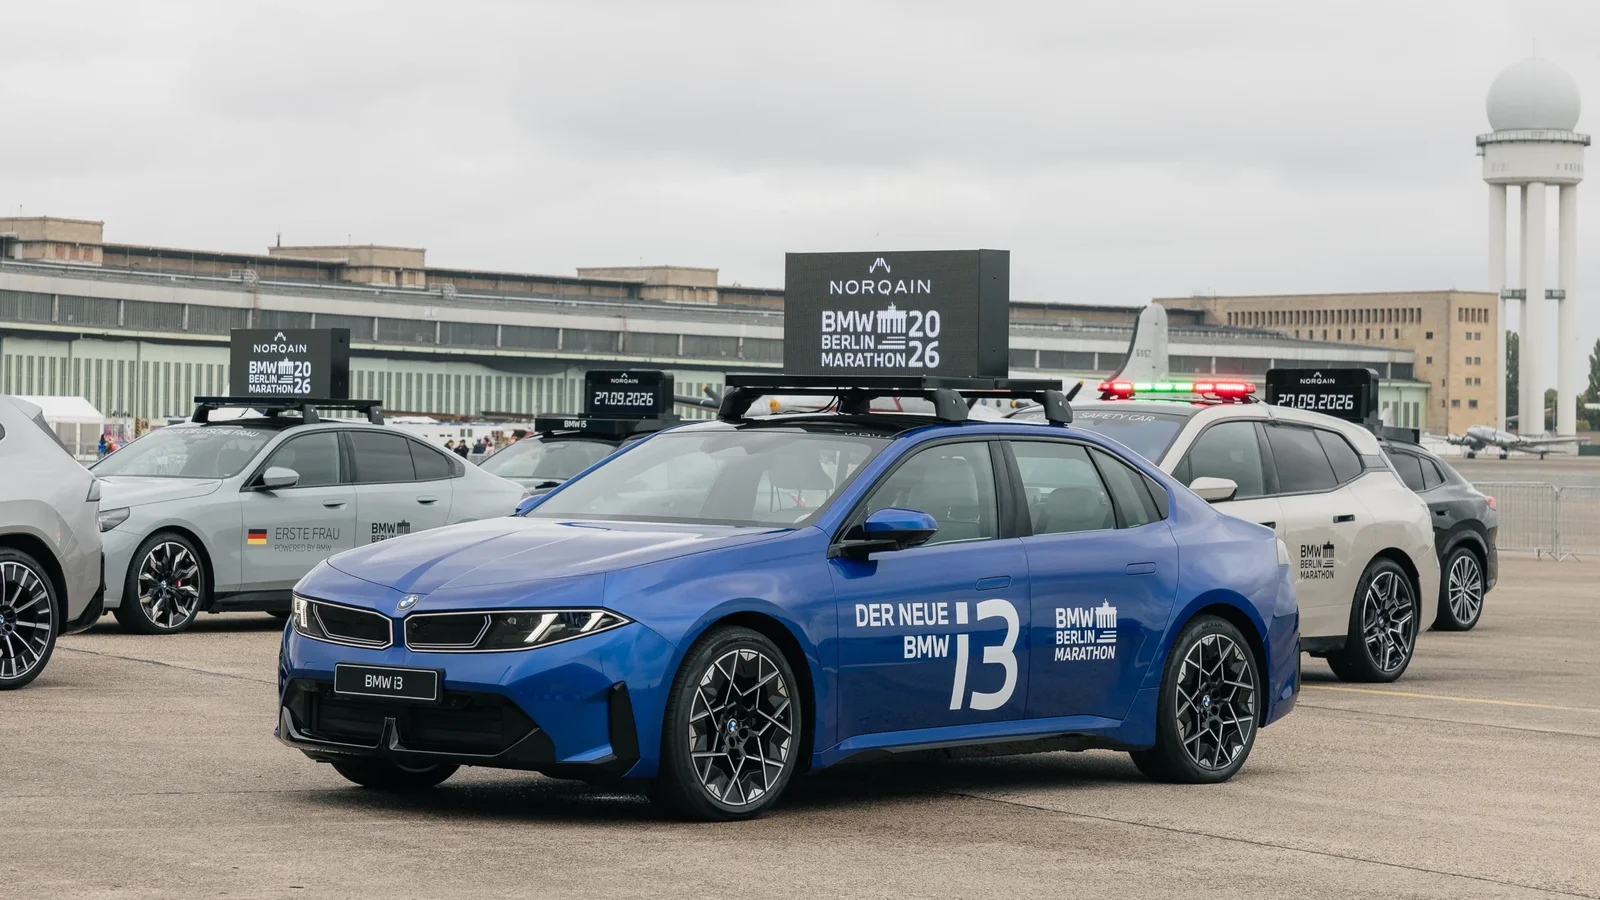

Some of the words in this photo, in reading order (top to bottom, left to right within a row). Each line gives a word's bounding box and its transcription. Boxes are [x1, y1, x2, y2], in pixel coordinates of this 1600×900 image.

[830, 280, 930, 295] NORQAIN
[822, 310, 874, 332] BMW
[908, 310, 940, 338] 20
[254, 344, 307, 353] NORQAIN
[822, 335, 874, 349] BERLIN
[822, 352, 905, 368] MARATHON
[908, 340, 940, 368] 26
[249, 361, 277, 374] BMW
[294, 361, 312, 377] 20
[249, 375, 277, 383] BERLIN
[294, 378, 311, 394] 26
[249, 385, 293, 393] MARATHON
[594, 392, 653, 406] 27.09.2026
[1278, 394, 1353, 410] 27.09.2026
[275, 528, 310, 540] ERSTE
[312, 528, 340, 540] FRAU
[372, 523, 395, 533] BMW
[274, 544, 306, 553] POWERED
[306, 544, 315, 552] BY
[1301, 545, 1321, 558] BMW
[1301, 560, 1322, 568] BERLIN
[1301, 570, 1334, 579] MARATHON
[855, 604, 894, 627] DER
[898, 602, 949, 626] NEUE
[1056, 607, 1094, 628] BMW
[1056, 630, 1095, 644] BERLIN
[904, 634, 950, 659] BMW
[949, 599, 1020, 710] i3
[1054, 646, 1116, 661] MARATHON
[365, 674, 392, 689] BMW
[394, 676, 403, 690] i3
